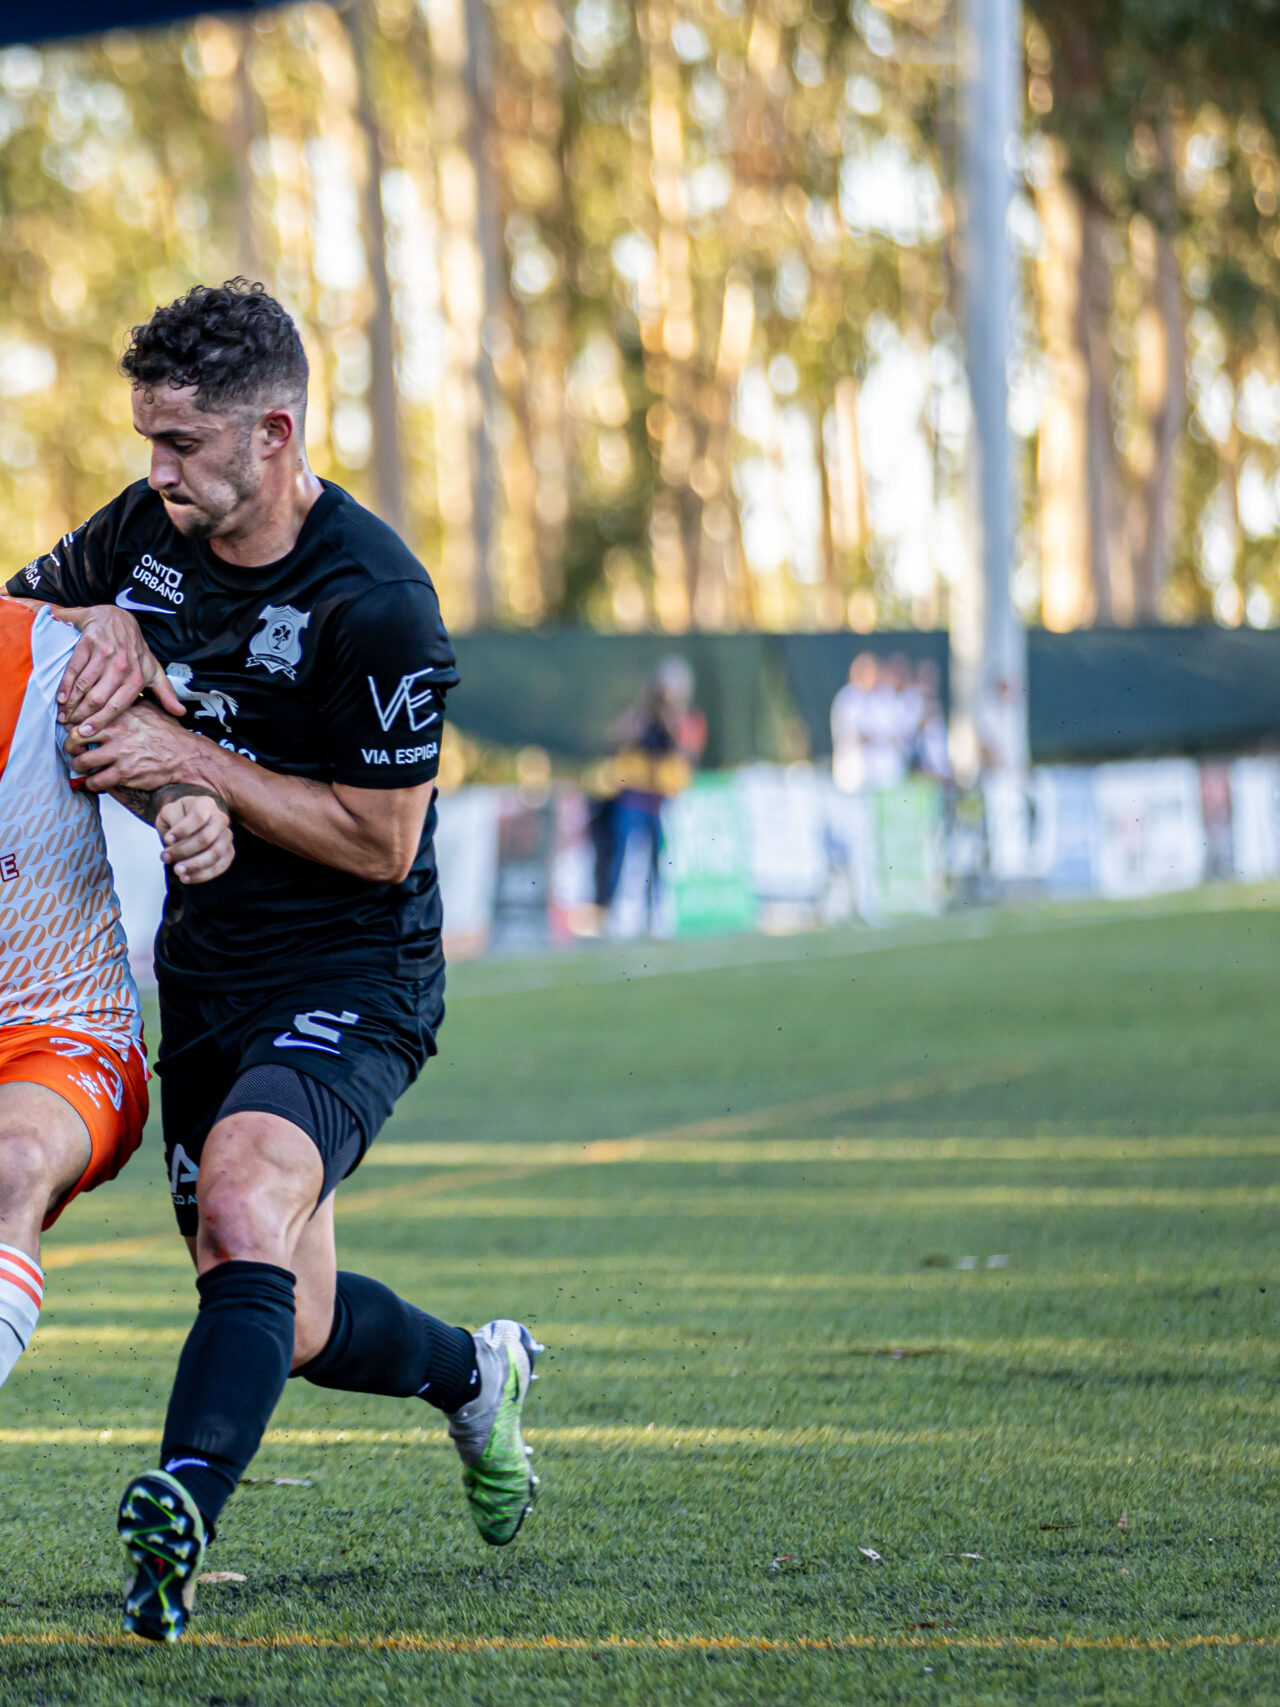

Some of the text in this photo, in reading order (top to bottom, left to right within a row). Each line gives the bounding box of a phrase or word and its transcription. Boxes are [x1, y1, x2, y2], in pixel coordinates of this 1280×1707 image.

[132, 565, 184, 604] URBANO
[367, 667, 438, 732] VE
[361, 741, 439, 765] VIA ESPIGA
